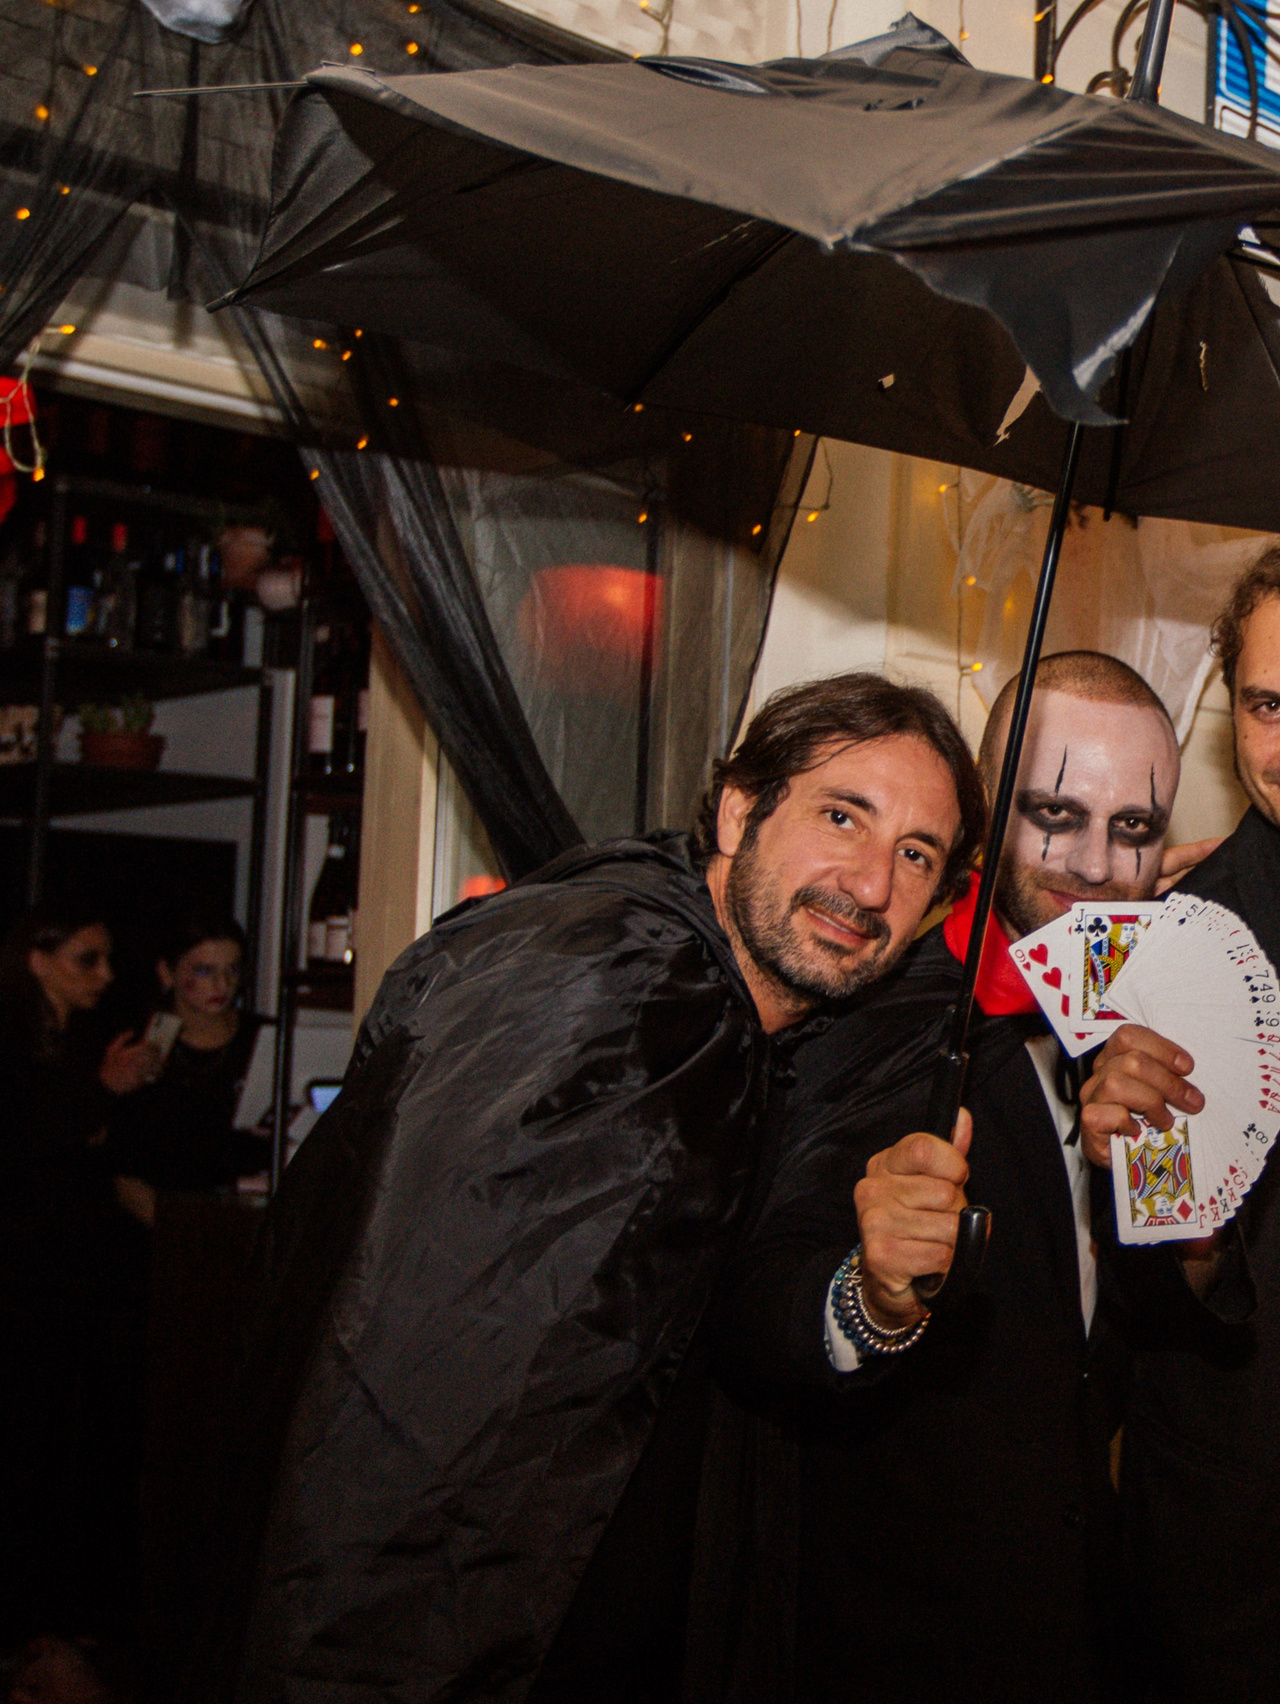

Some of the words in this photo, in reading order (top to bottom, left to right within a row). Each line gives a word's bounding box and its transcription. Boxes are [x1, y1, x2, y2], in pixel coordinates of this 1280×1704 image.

[1075, 908, 1085, 923] J
[1255, 969, 1270, 979] 7
[1260, 983, 1274, 992] 4
[1255, 1131, 1269, 1144] 8
[1226, 1187, 1238, 1203] K
[1219, 1198, 1231, 1214] K
[1209, 1207, 1222, 1222] K
